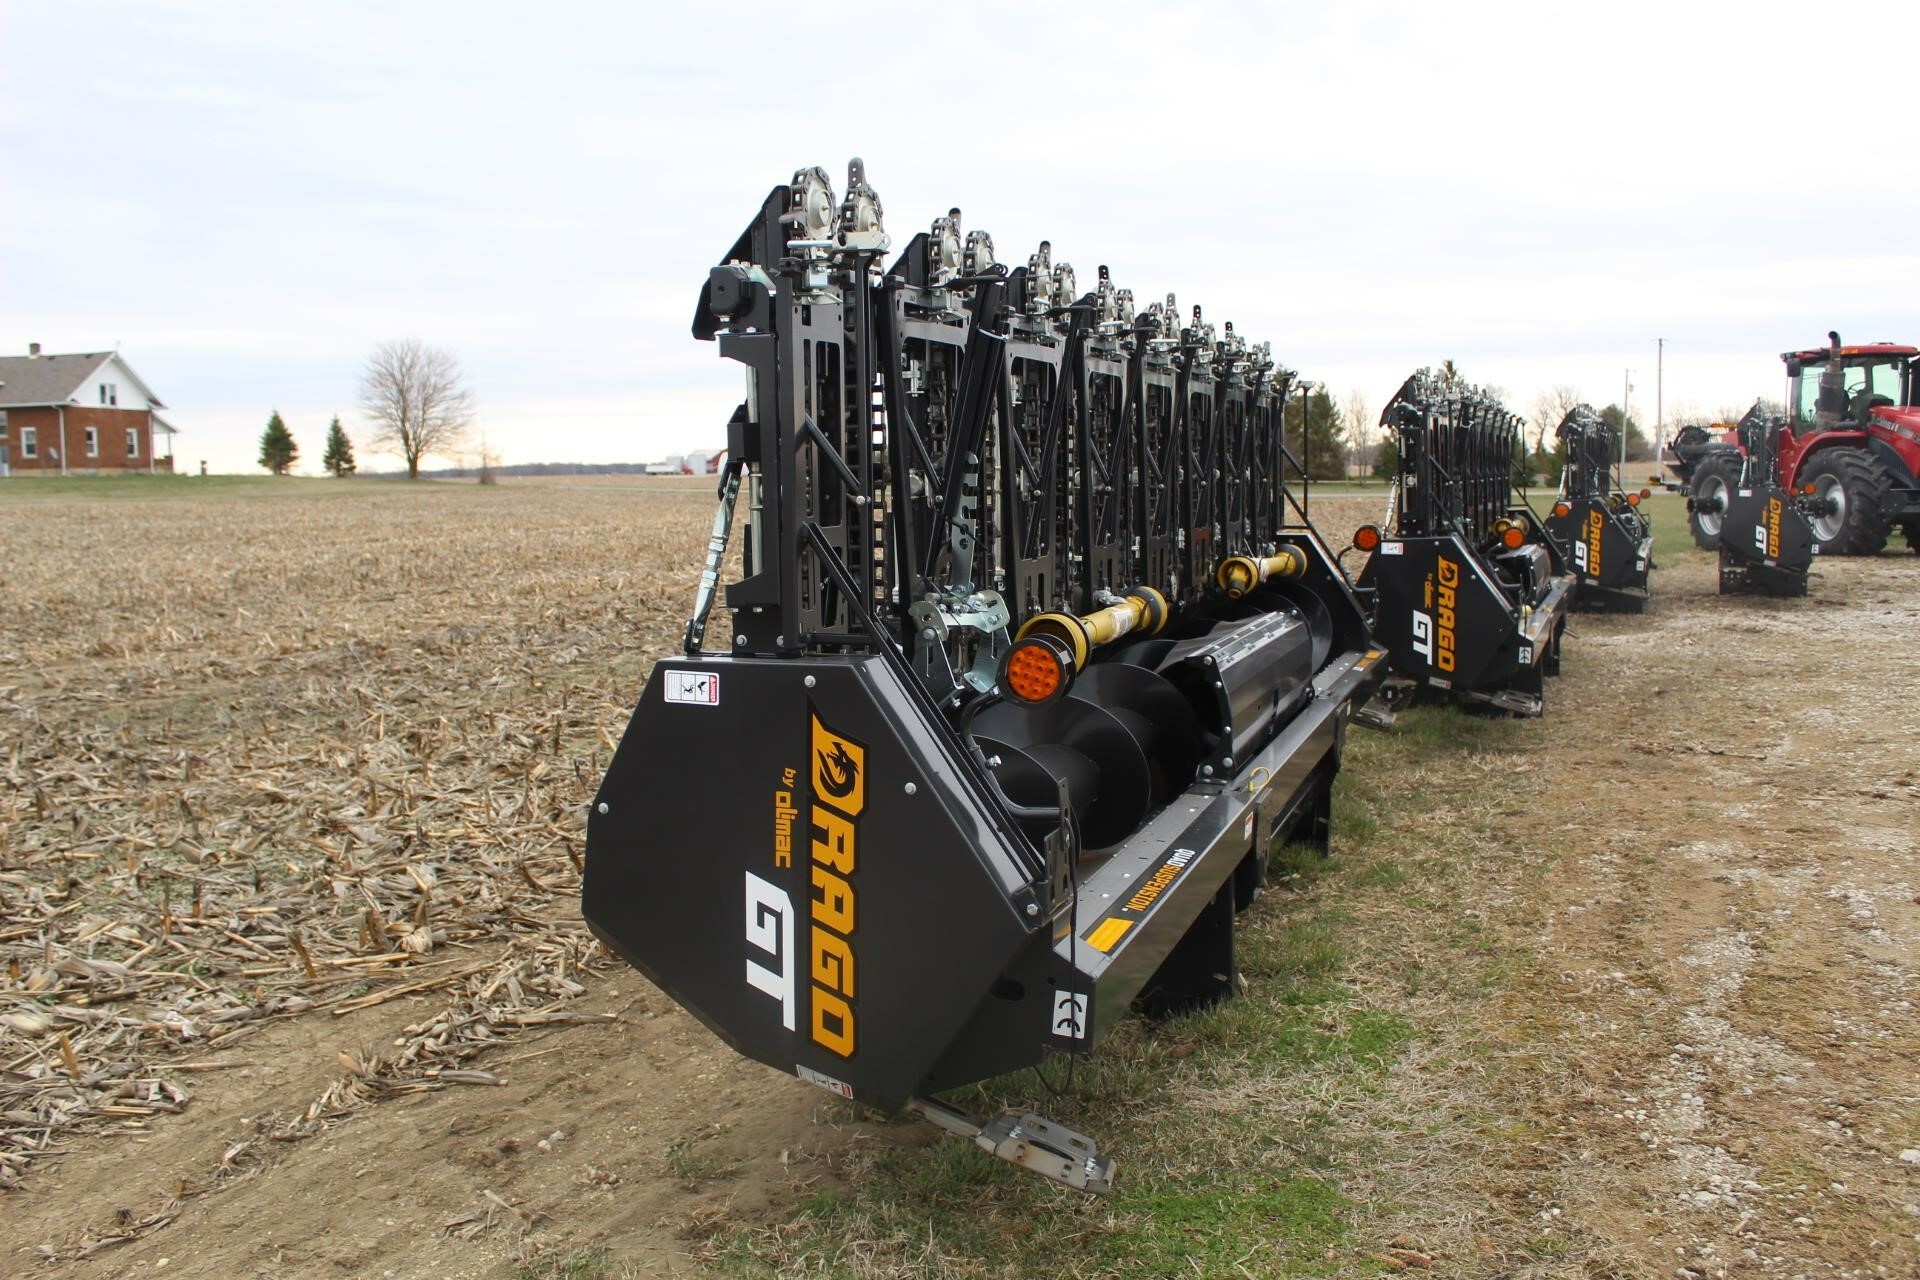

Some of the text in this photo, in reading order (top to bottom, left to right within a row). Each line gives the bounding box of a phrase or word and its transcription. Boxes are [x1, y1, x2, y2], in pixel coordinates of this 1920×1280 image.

[1575, 540, 1588, 573] GT
[1590, 511, 1603, 577] DRAGO
[1755, 525, 1768, 555] GT
[1412, 609, 1433, 666] GT
[1438, 555, 1460, 673] DRAGO
[775, 767, 798, 869] by olimac
[811, 713, 865, 1058] DRAGO
[745, 870, 796, 1032] GT
